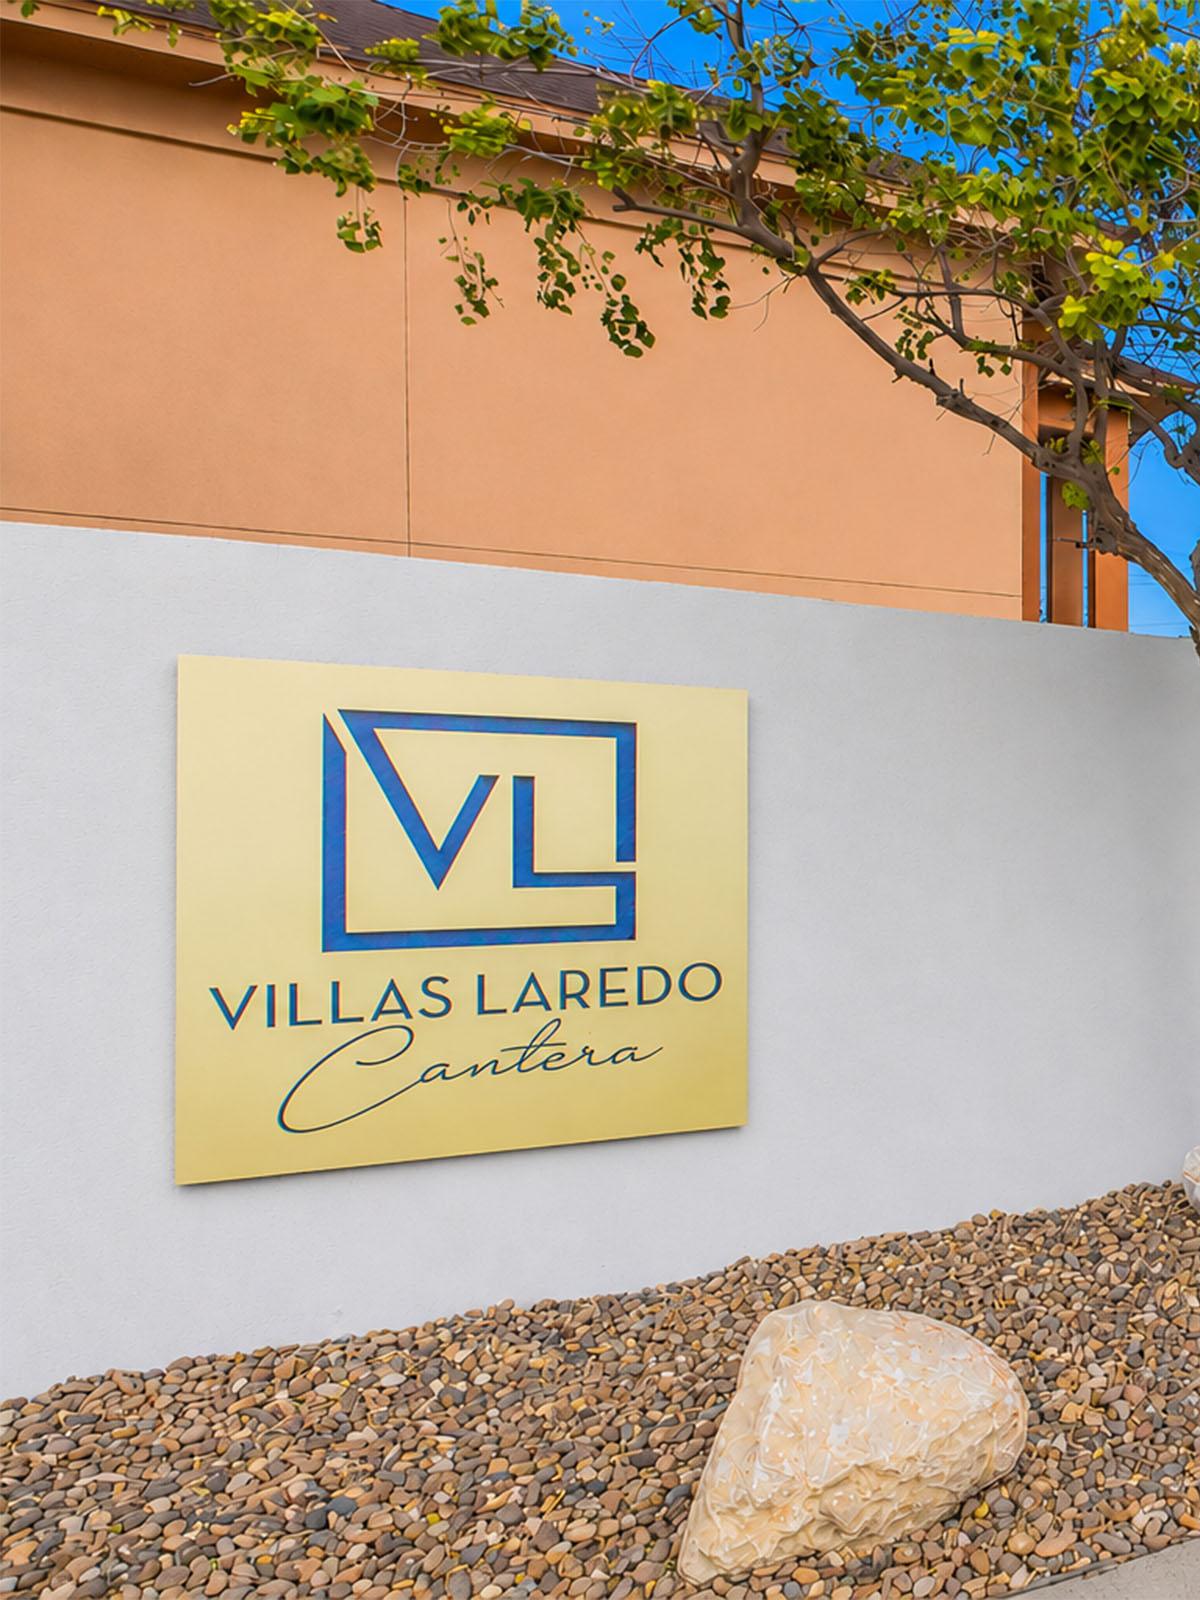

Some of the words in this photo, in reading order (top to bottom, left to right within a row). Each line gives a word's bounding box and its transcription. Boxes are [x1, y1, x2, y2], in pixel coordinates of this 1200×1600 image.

[338, 709, 636, 890] VL
[209, 976, 453, 1030] VILLAS
[476, 961, 723, 1016] LAREDO
[277, 1018, 663, 1134] Cantera
